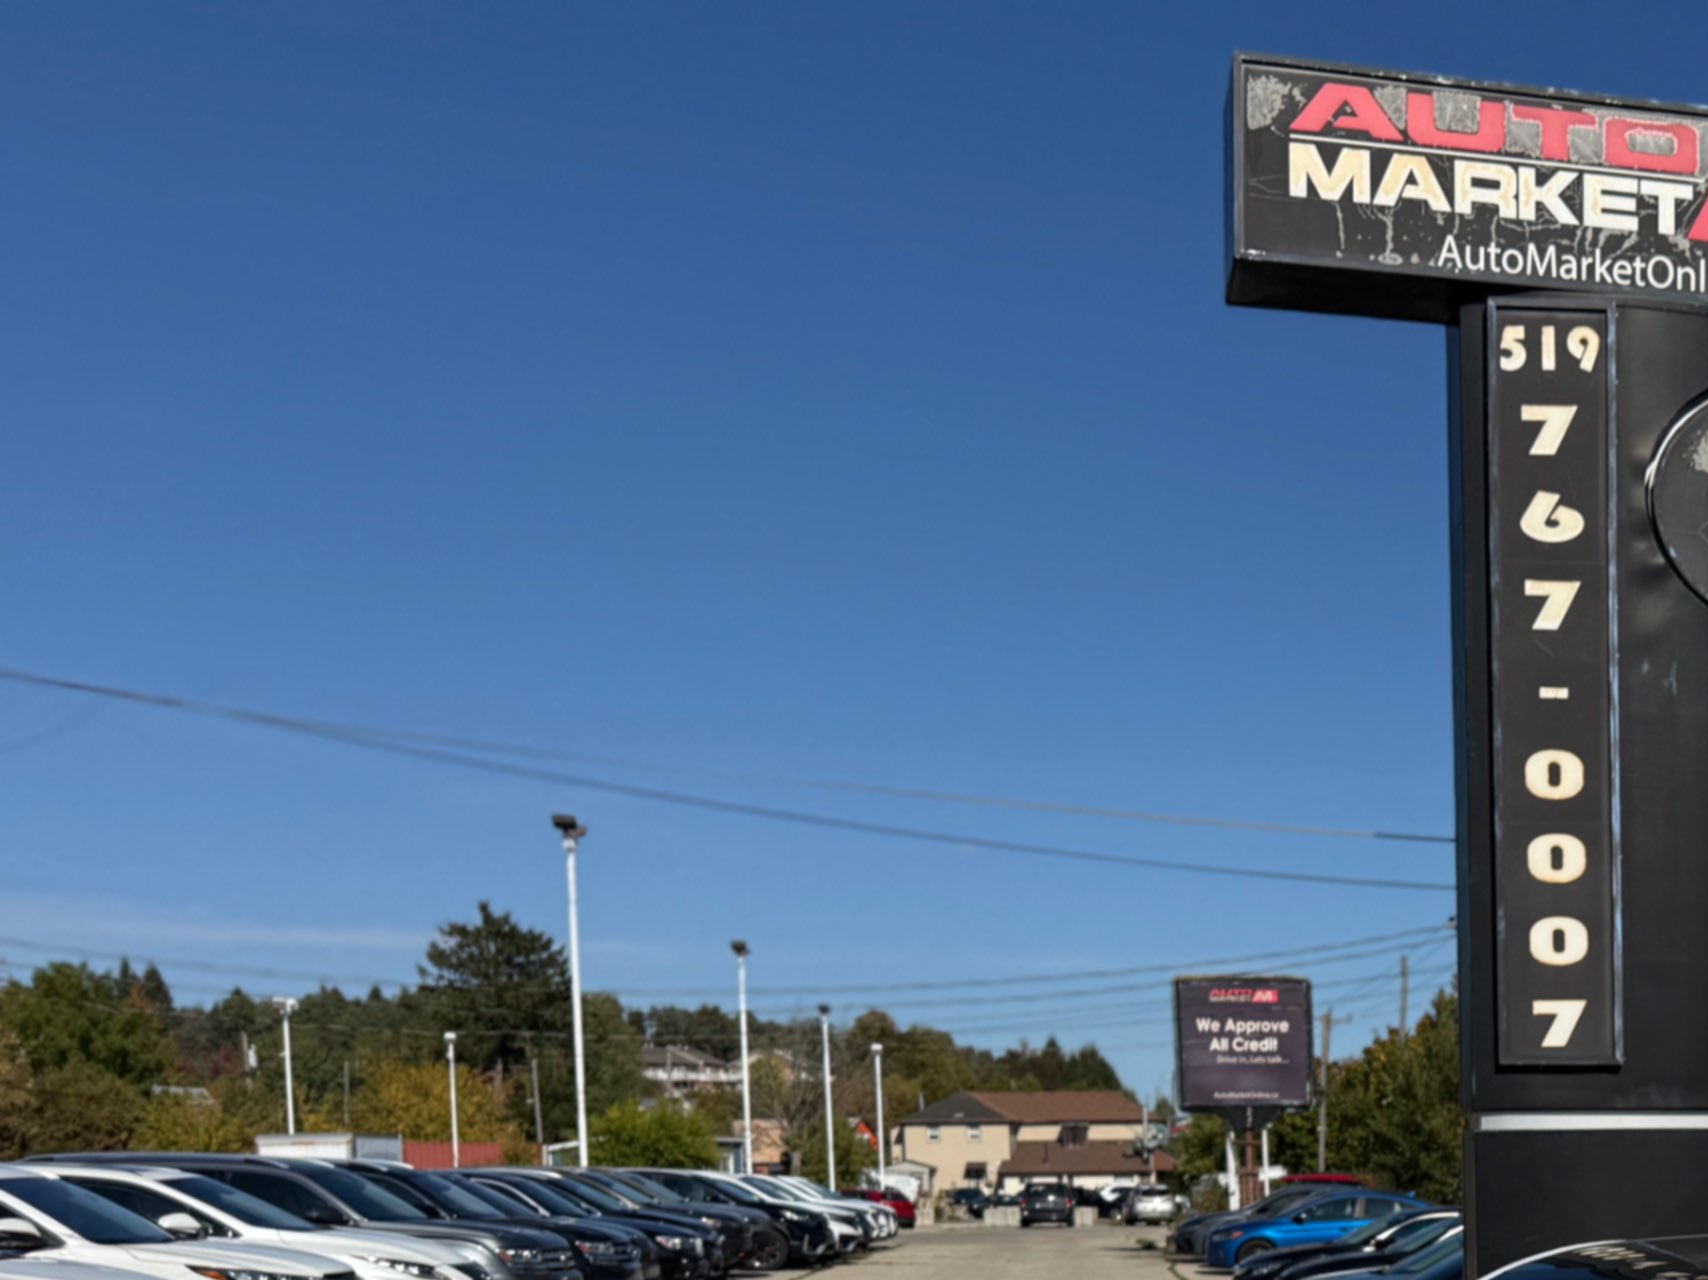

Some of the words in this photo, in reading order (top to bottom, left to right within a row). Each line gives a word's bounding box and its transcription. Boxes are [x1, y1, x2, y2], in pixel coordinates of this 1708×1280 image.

[1289, 82, 1700, 176] AUTO
[1288, 142, 1695, 236] MARKET
[1499, 324, 1600, 373] 519
[1195, 1018, 1220, 1033] We
[1225, 1018, 1290, 1034] Approve
[1209, 1037, 1228, 1052] All
[1232, 1037, 1278, 1052] Credit
